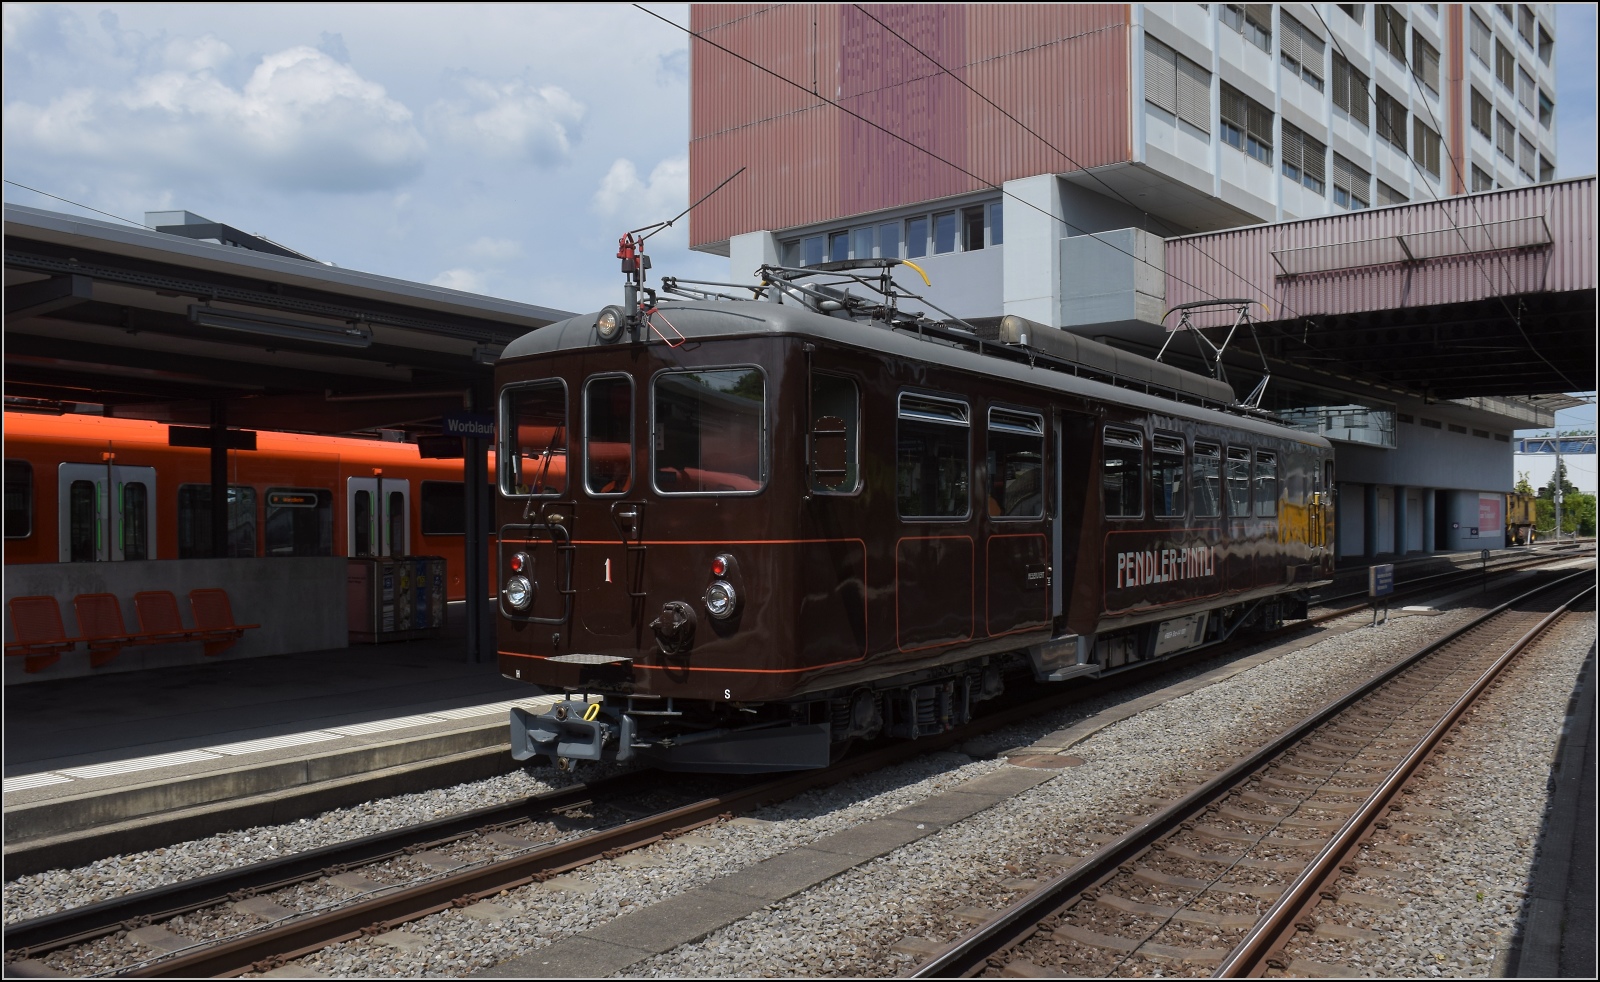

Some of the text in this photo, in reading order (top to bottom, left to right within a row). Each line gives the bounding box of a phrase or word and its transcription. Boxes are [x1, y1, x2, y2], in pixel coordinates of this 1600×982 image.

[604, 557, 612, 583] 1
[1117, 545, 1215, 589] PENDLER-PINTLI
[724, 688, 731, 700] S
